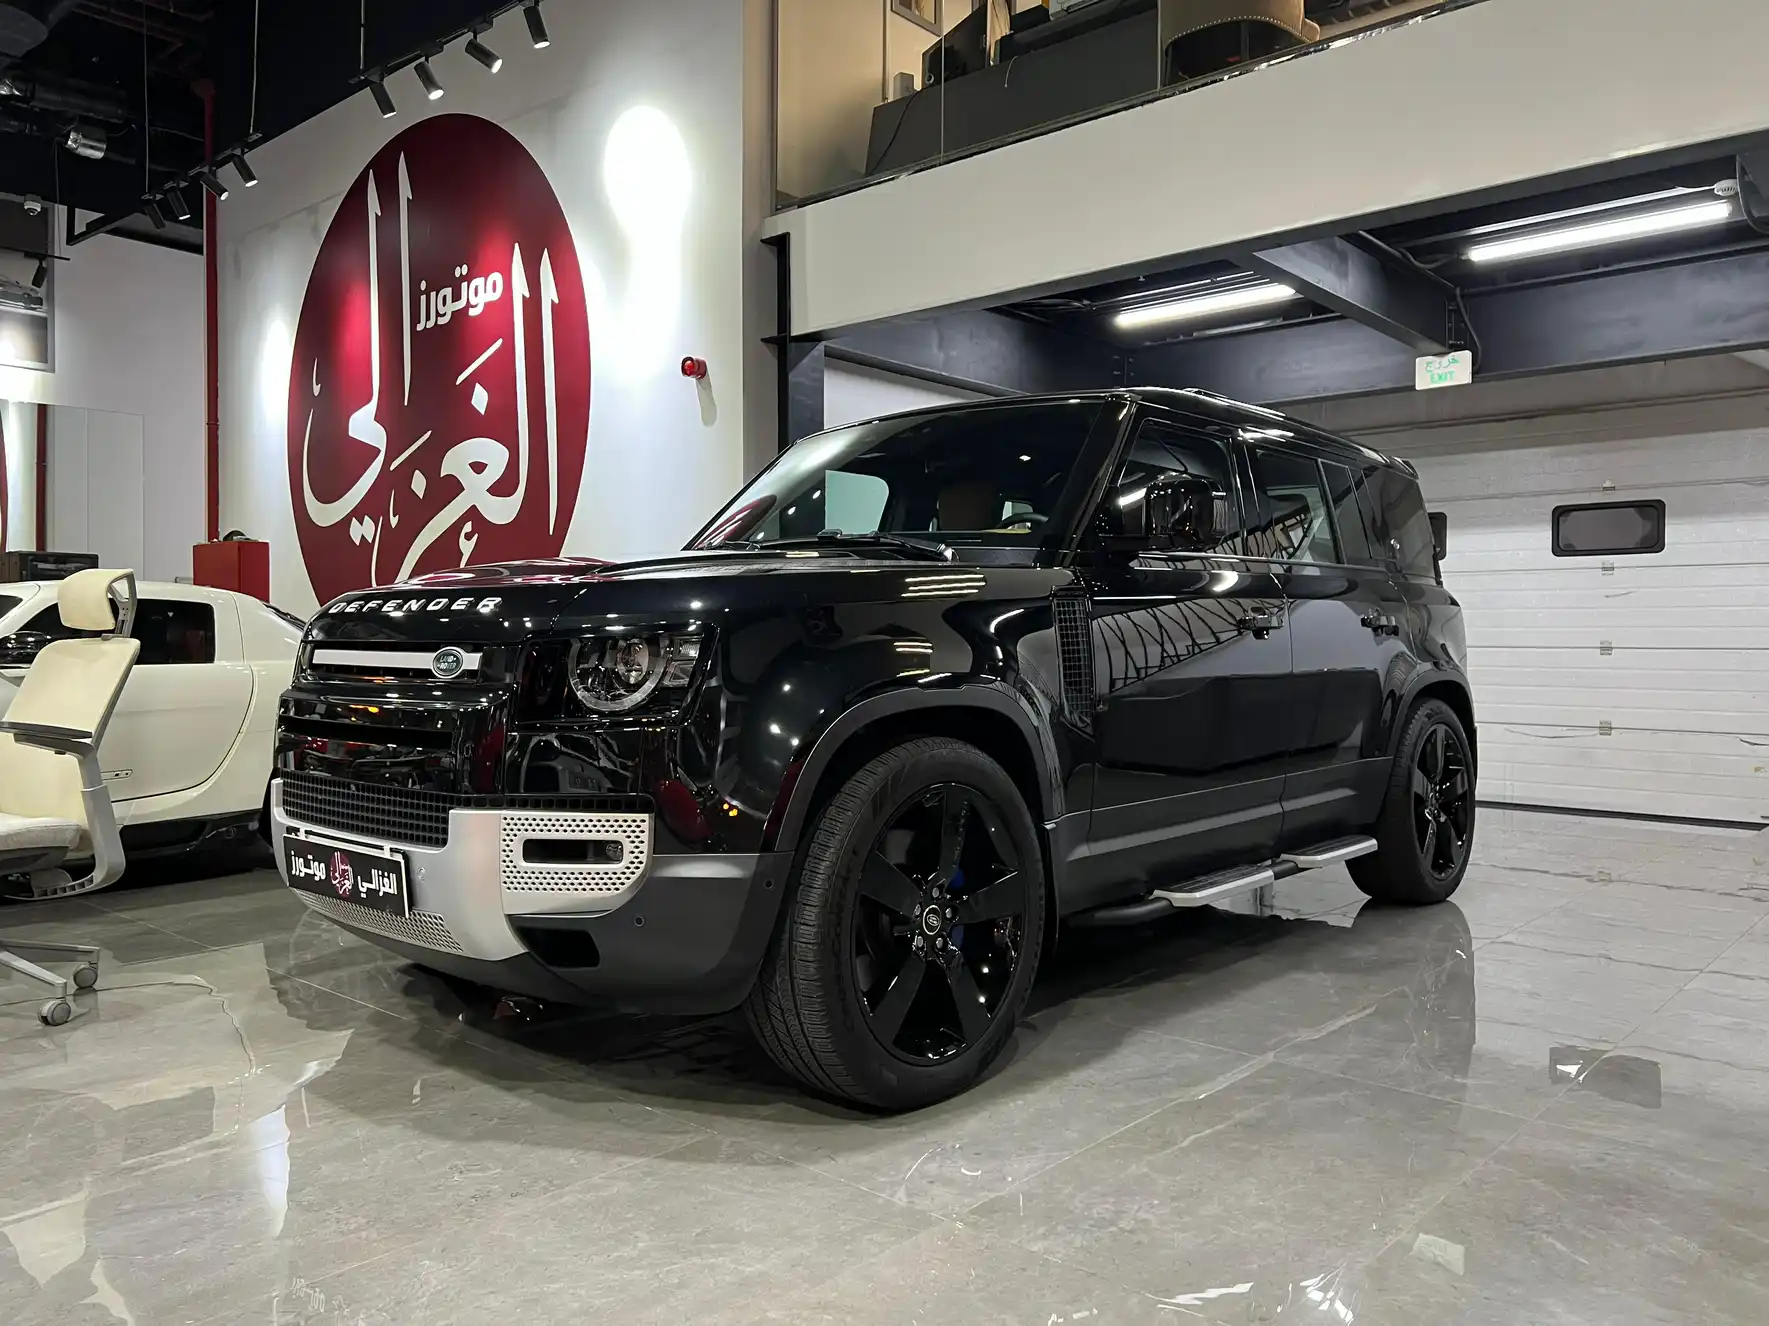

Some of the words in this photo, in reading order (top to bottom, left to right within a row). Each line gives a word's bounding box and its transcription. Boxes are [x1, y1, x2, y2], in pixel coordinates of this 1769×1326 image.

[416, 264, 503, 331] موتورز
[1430, 371, 1455, 384] EXIT
[328, 597, 502, 614] DEFENDER
[291, 850, 326, 881] موتورز
[357, 868, 398, 898] الغزالي
